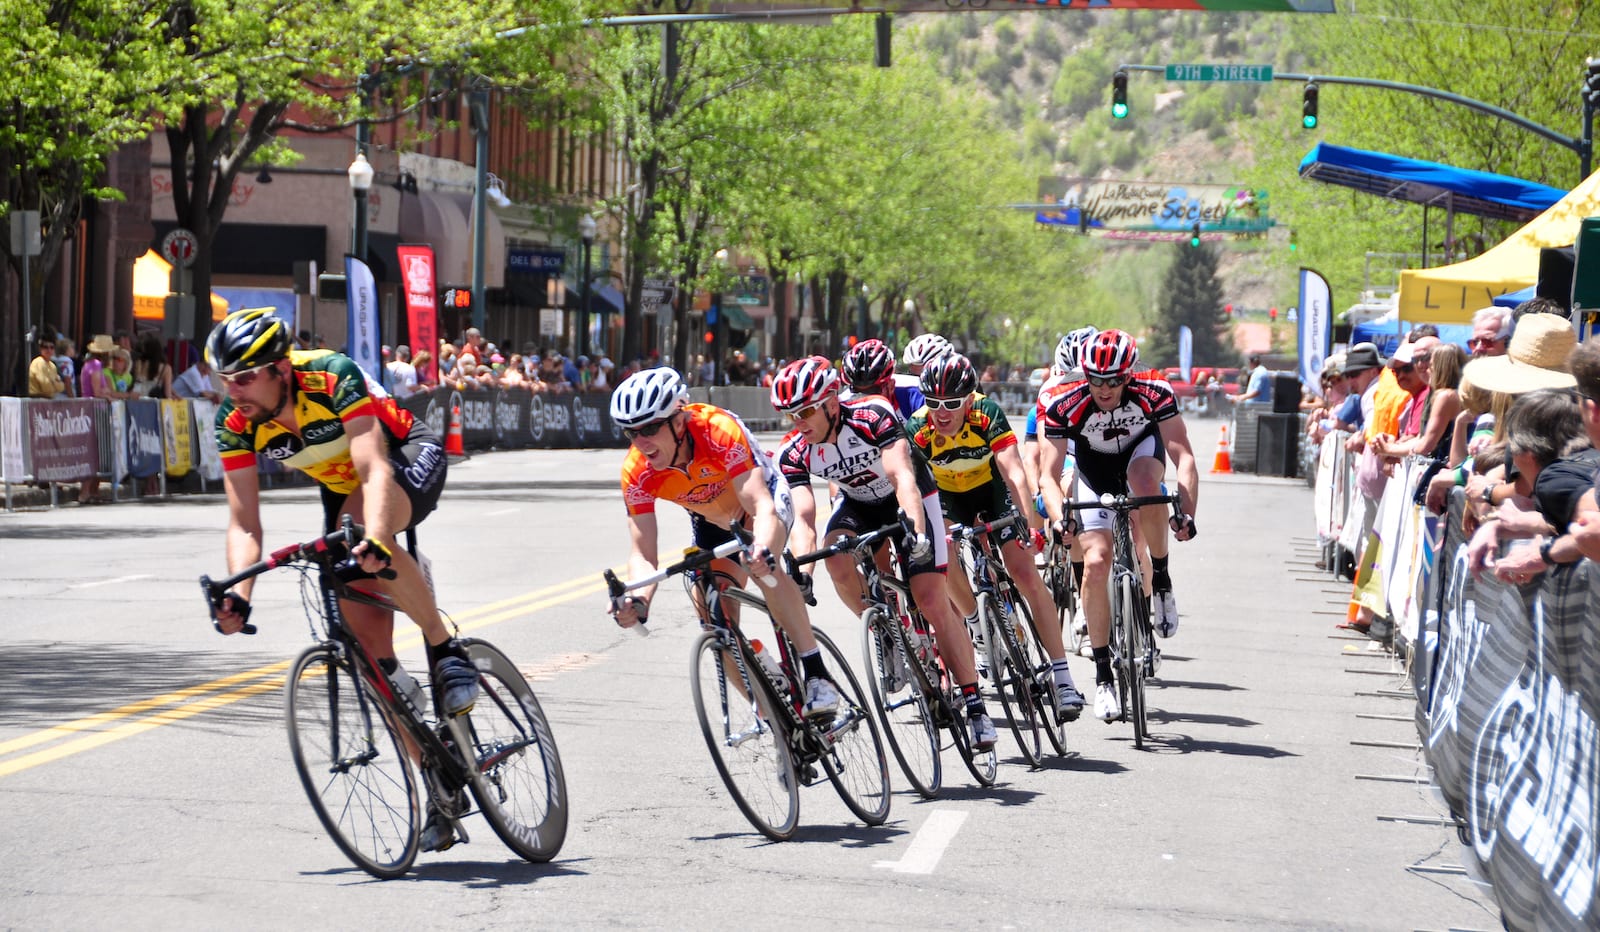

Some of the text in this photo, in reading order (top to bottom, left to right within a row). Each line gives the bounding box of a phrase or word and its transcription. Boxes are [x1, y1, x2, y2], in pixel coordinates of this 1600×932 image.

[1174, 66, 1264, 80] 9TH STREET
[1085, 195, 1229, 223] Humane Society
[510, 255, 529, 265] DEL
